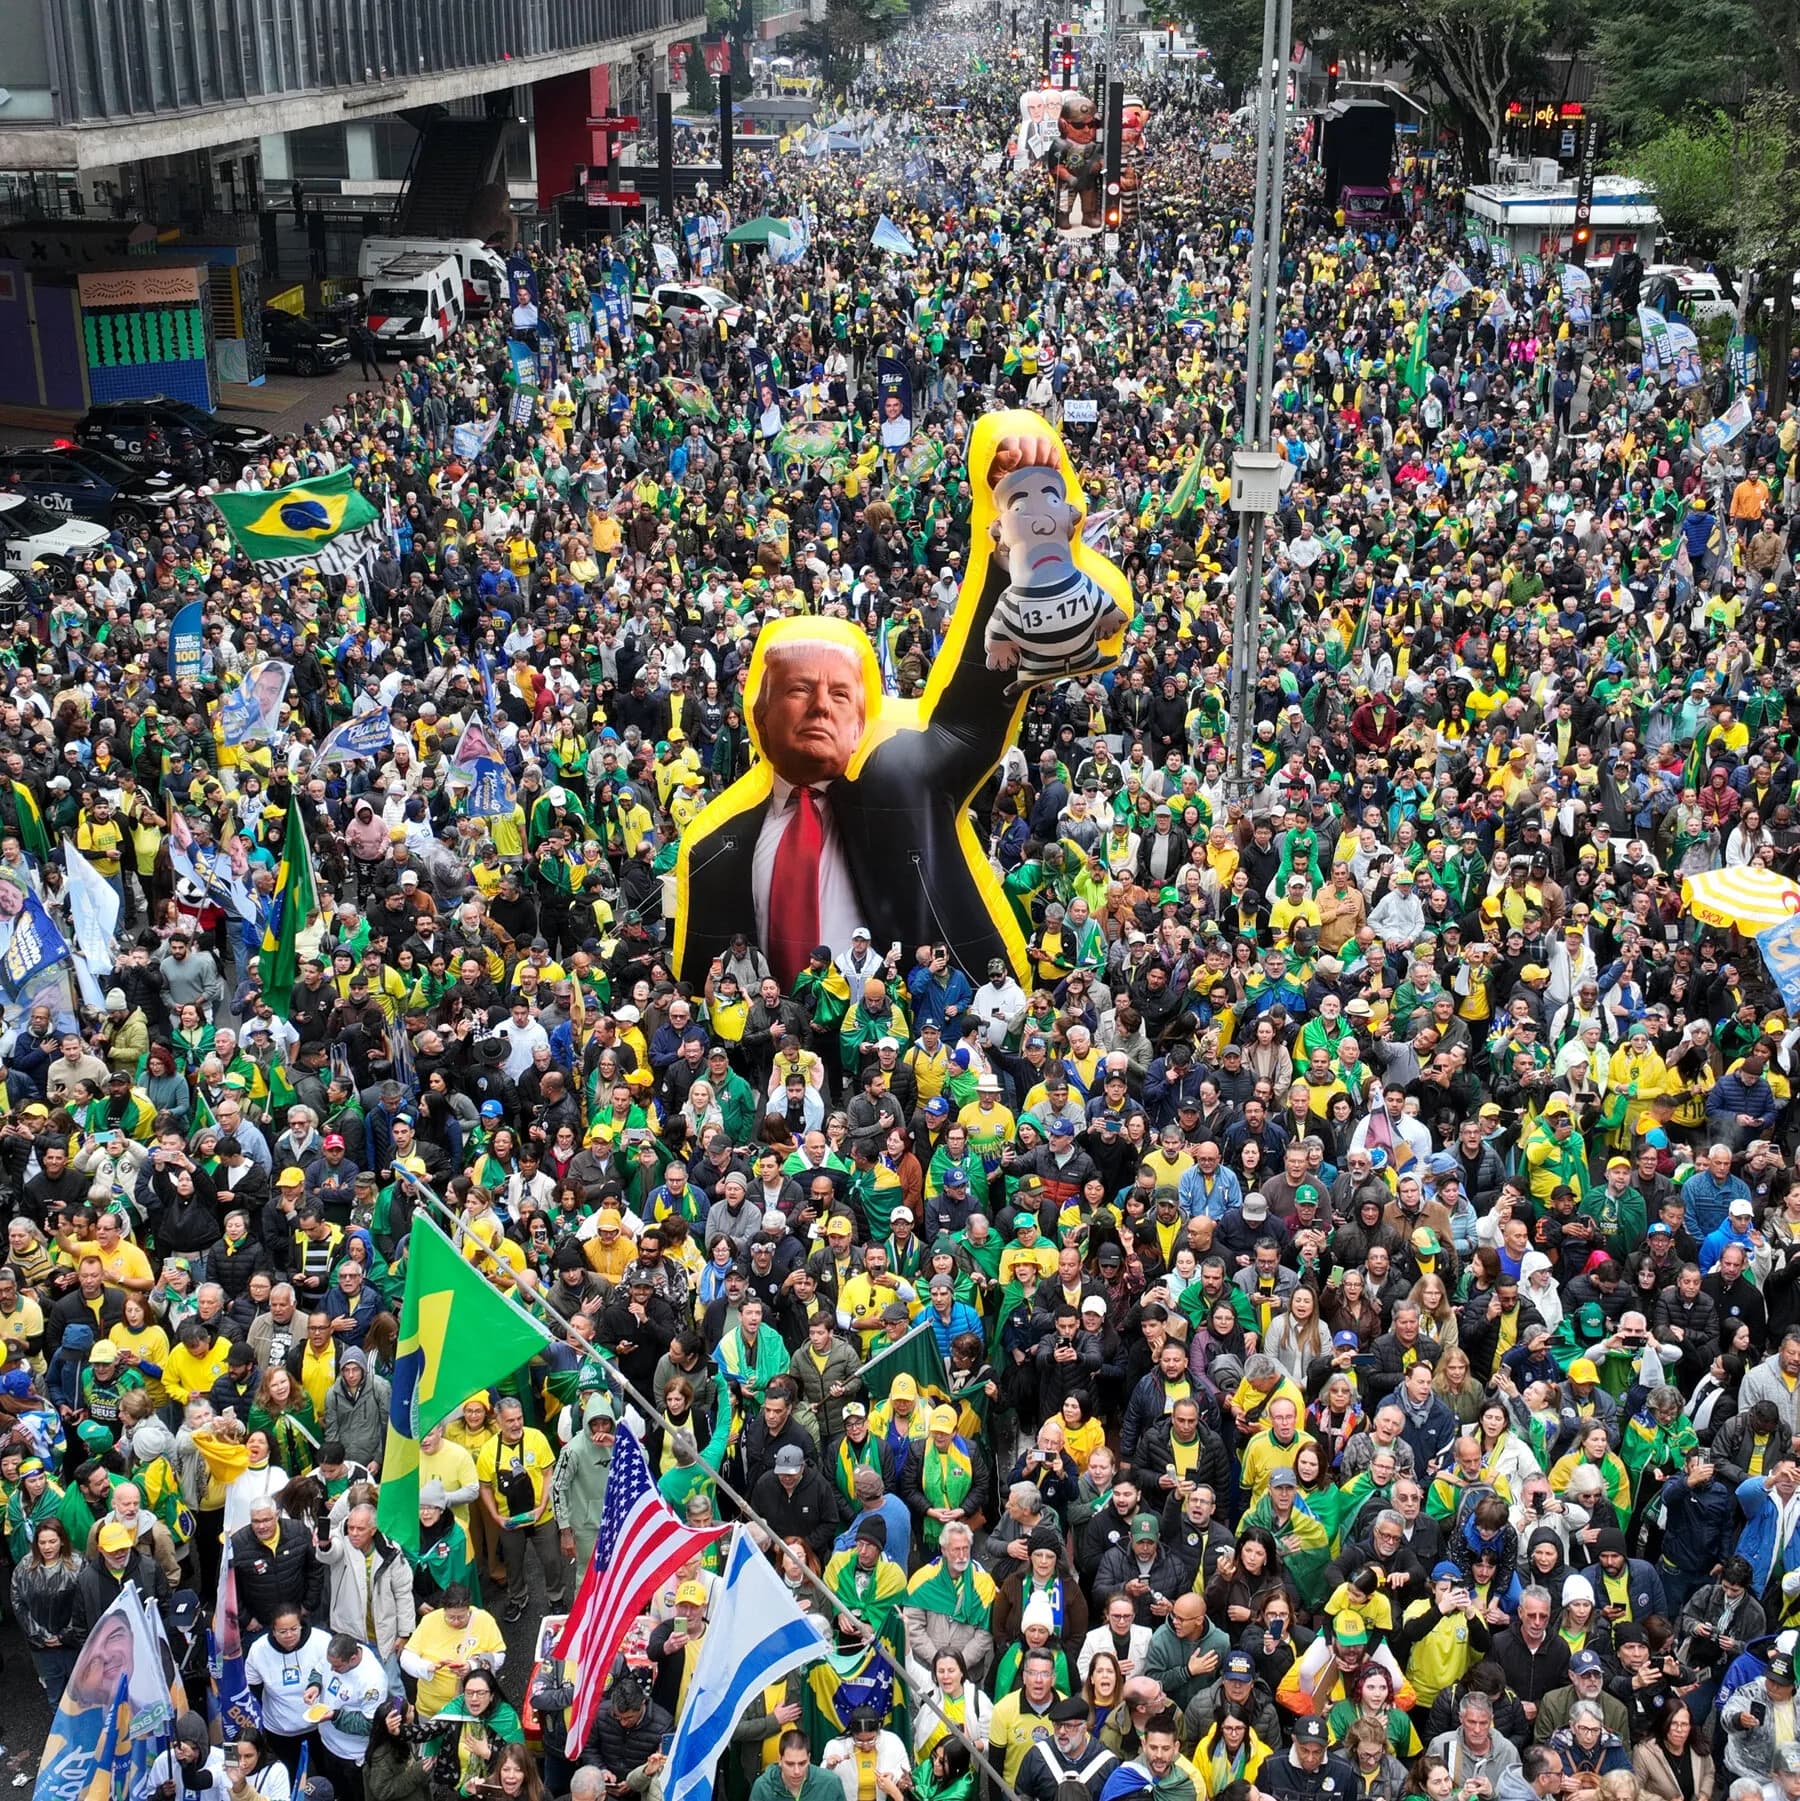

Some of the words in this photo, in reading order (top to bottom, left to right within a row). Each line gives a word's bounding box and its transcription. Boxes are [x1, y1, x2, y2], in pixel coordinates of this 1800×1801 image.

[1586, 122, 1598, 157] Branca
[174, 650, 201, 663] 1001
[91, 1407, 117, 1418] DEUS
[682, 1585, 696, 1596] 22
[285, 1671, 299, 1681] PL
